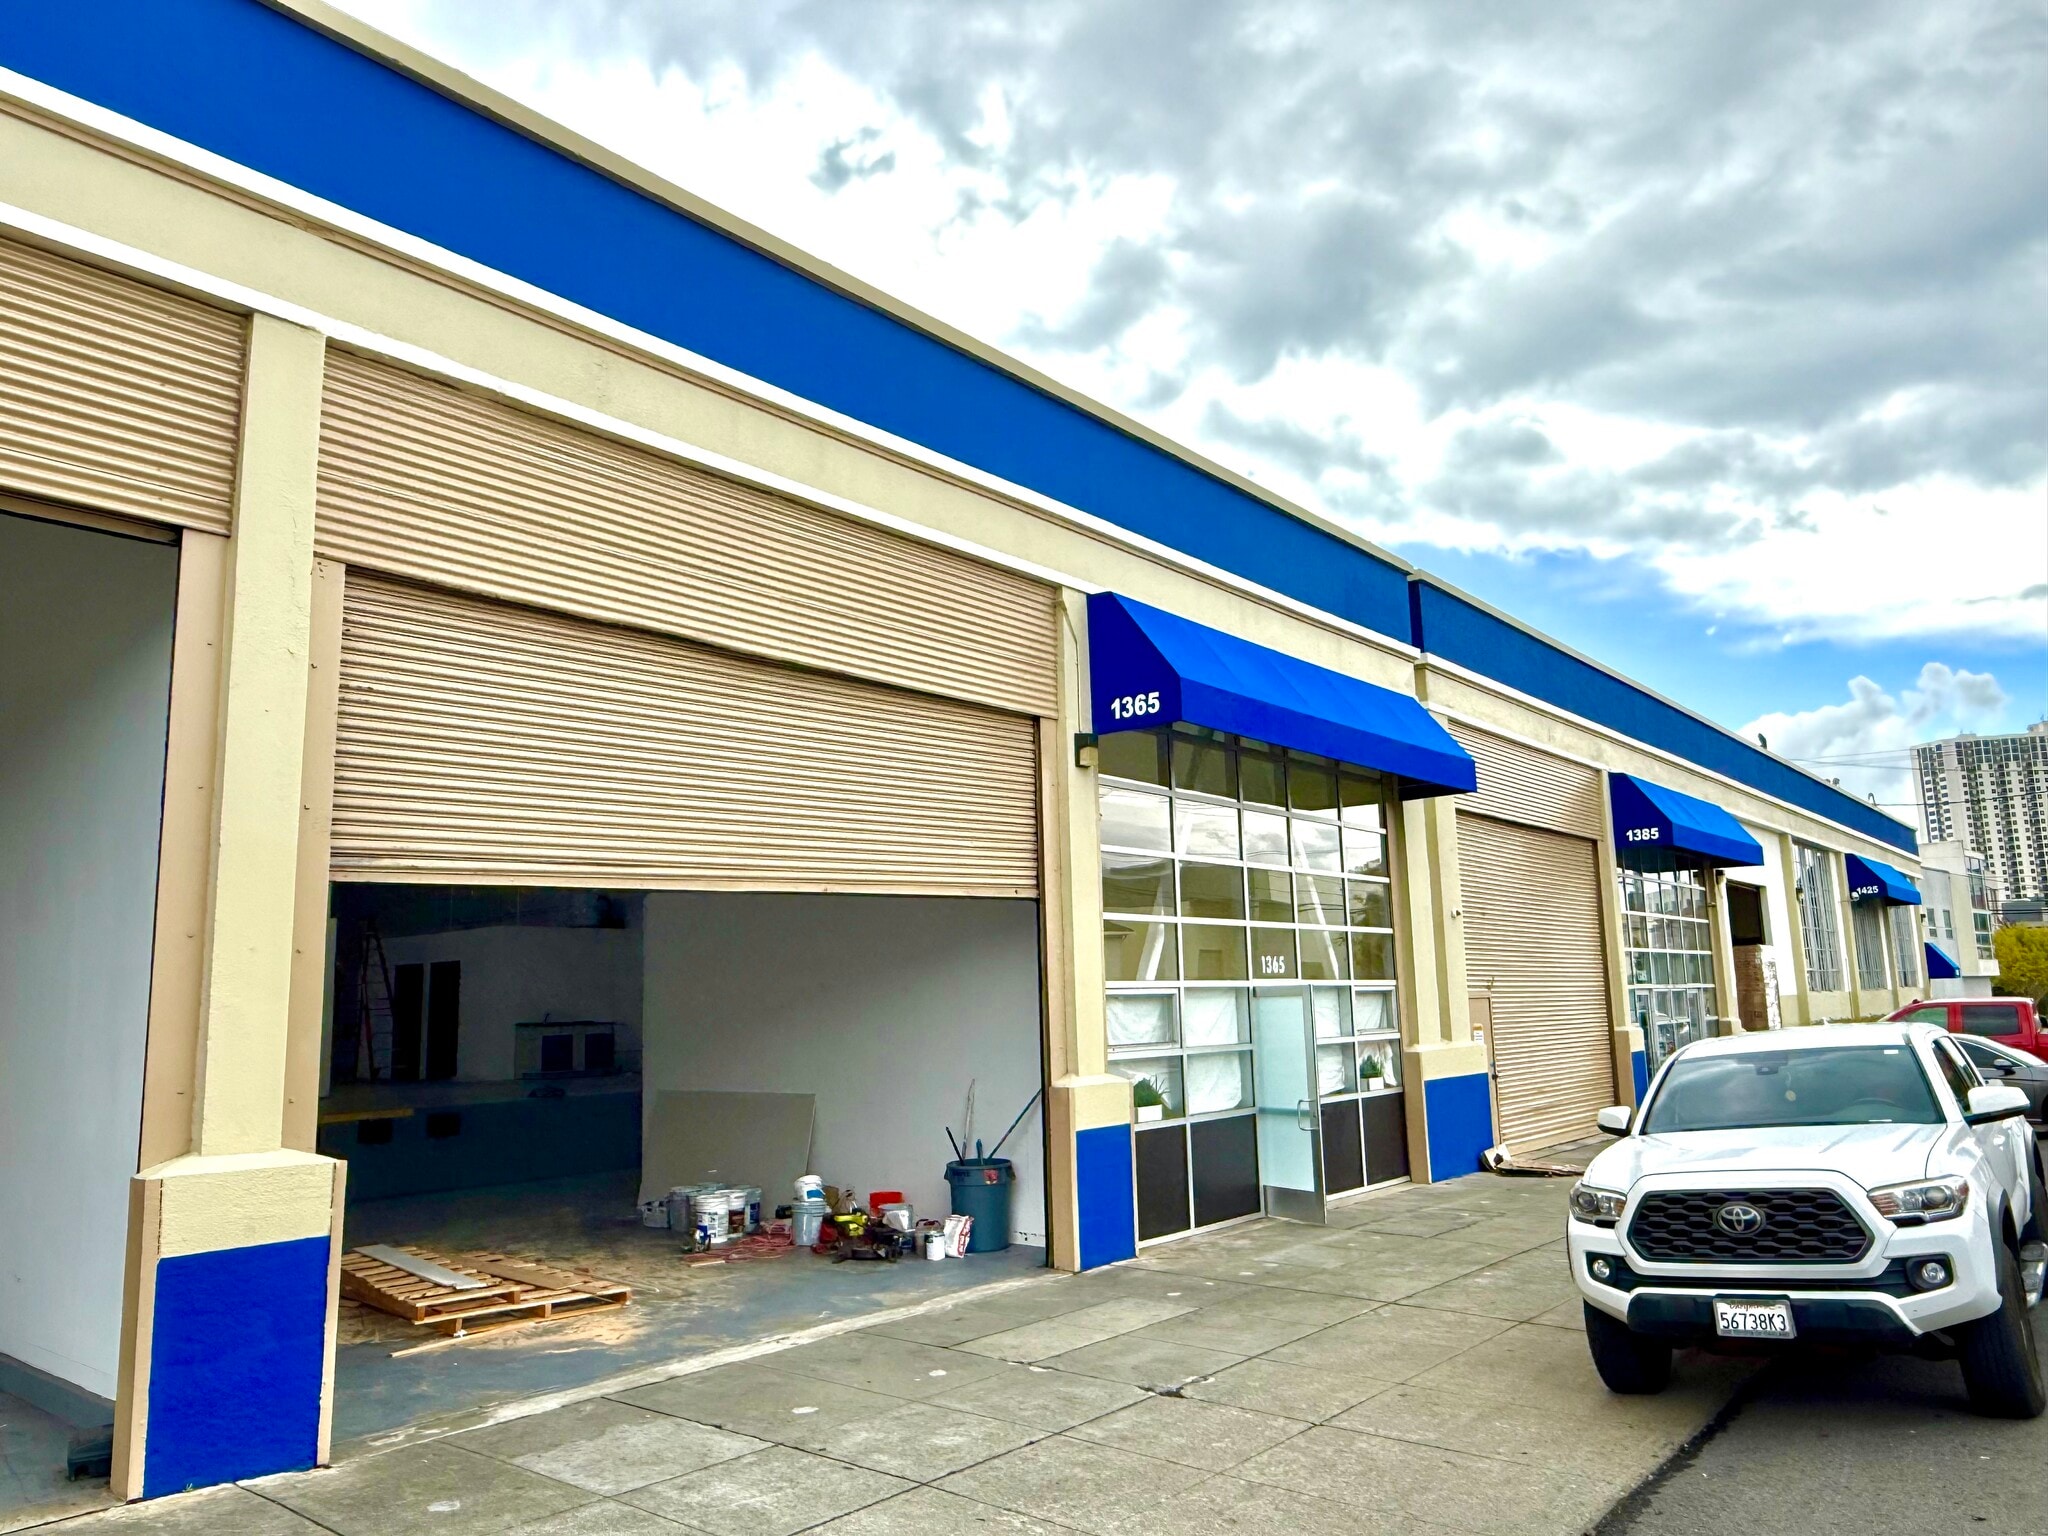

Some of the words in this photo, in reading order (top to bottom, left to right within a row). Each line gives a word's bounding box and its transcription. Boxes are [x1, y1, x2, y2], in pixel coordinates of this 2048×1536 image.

[1111, 691, 1160, 720] 1365
[1626, 827, 1659, 841] 1385
[1856, 885, 1879, 895] 1425
[1261, 955, 1286, 974] 1365
[1720, 1312, 1786, 1331] 56738K3
